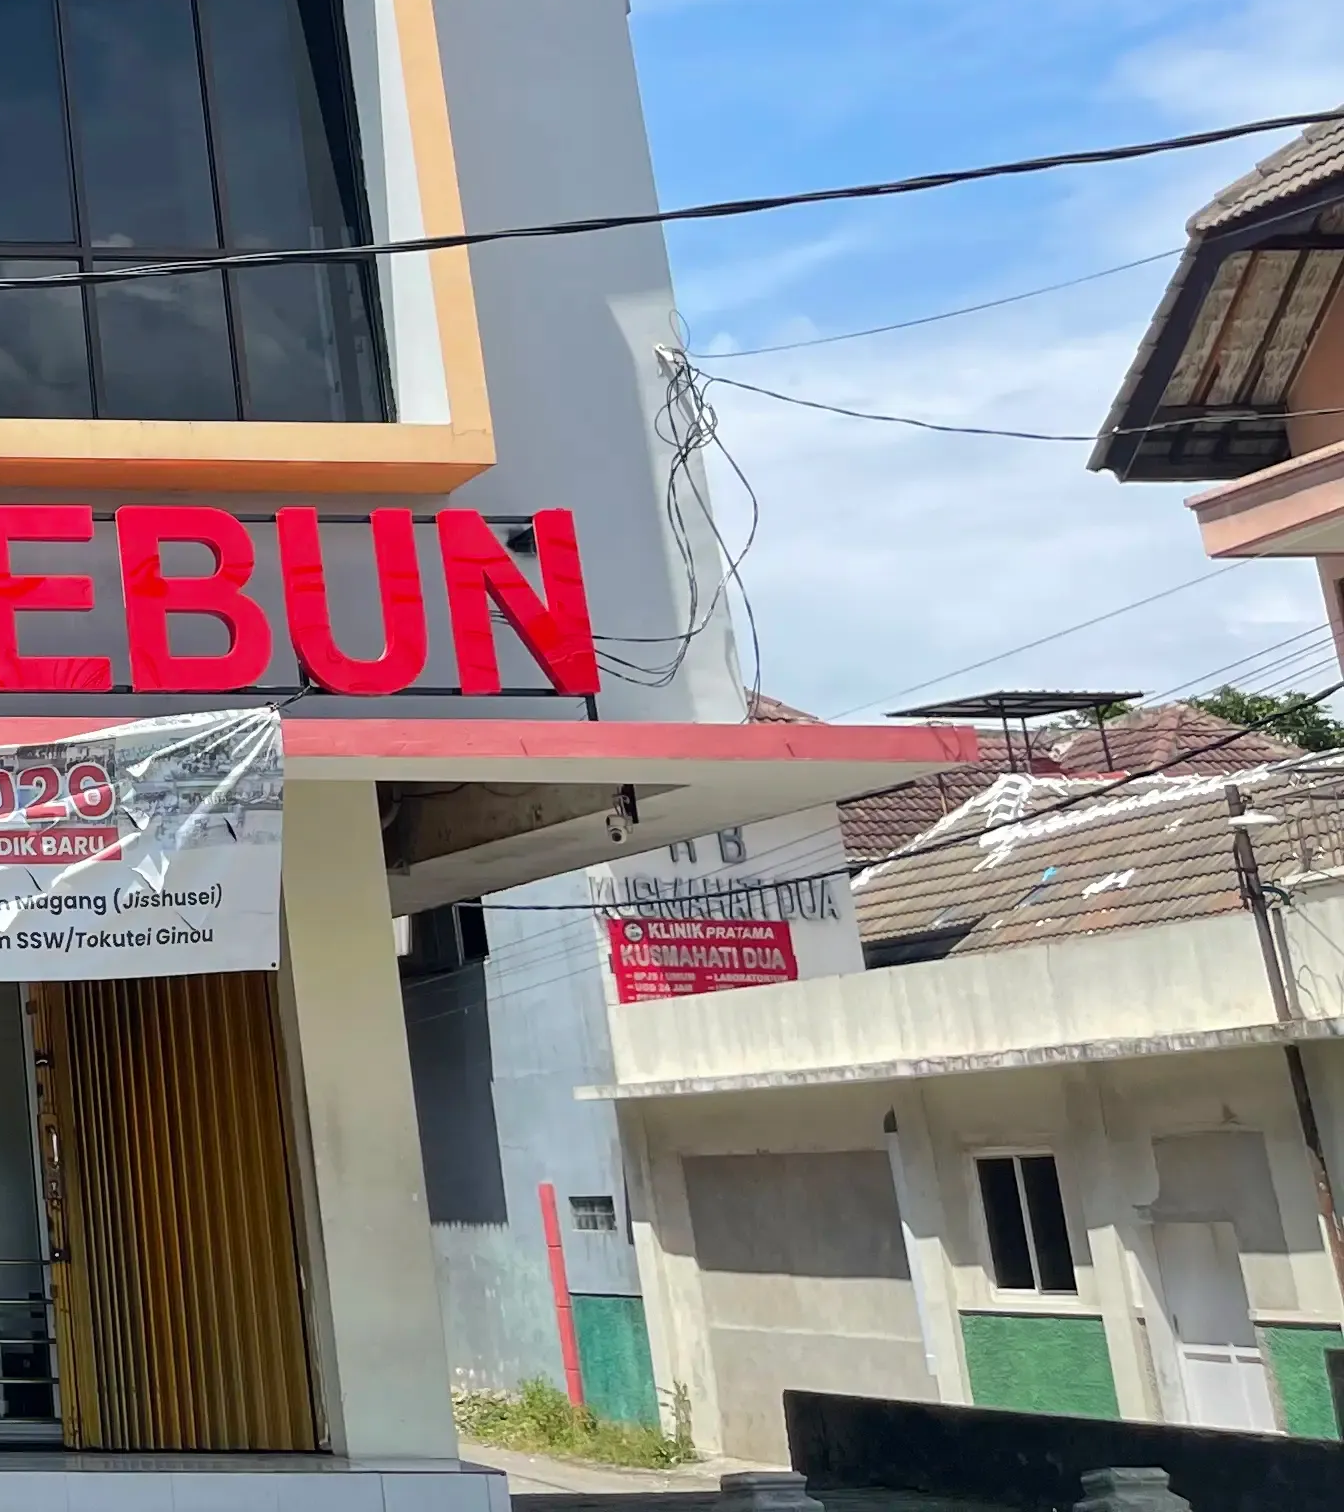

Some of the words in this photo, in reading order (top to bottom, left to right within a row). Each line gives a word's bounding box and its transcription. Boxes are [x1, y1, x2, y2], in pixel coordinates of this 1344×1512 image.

[43, 835, 105, 856] BARU
[15, 893, 107, 916] Magang
[113, 883, 223, 914] (Jisshusei)
[774, 878, 840, 920] DUA
[16, 926, 152, 953] SSW/Tokutei
[156, 926, 213, 946] Ginou
[647, 922, 705, 939] KLINIK
[706, 927, 774, 940] PRATAMA
[619, 944, 739, 969] KUSMAHATI
[743, 946, 786, 970] DUA
